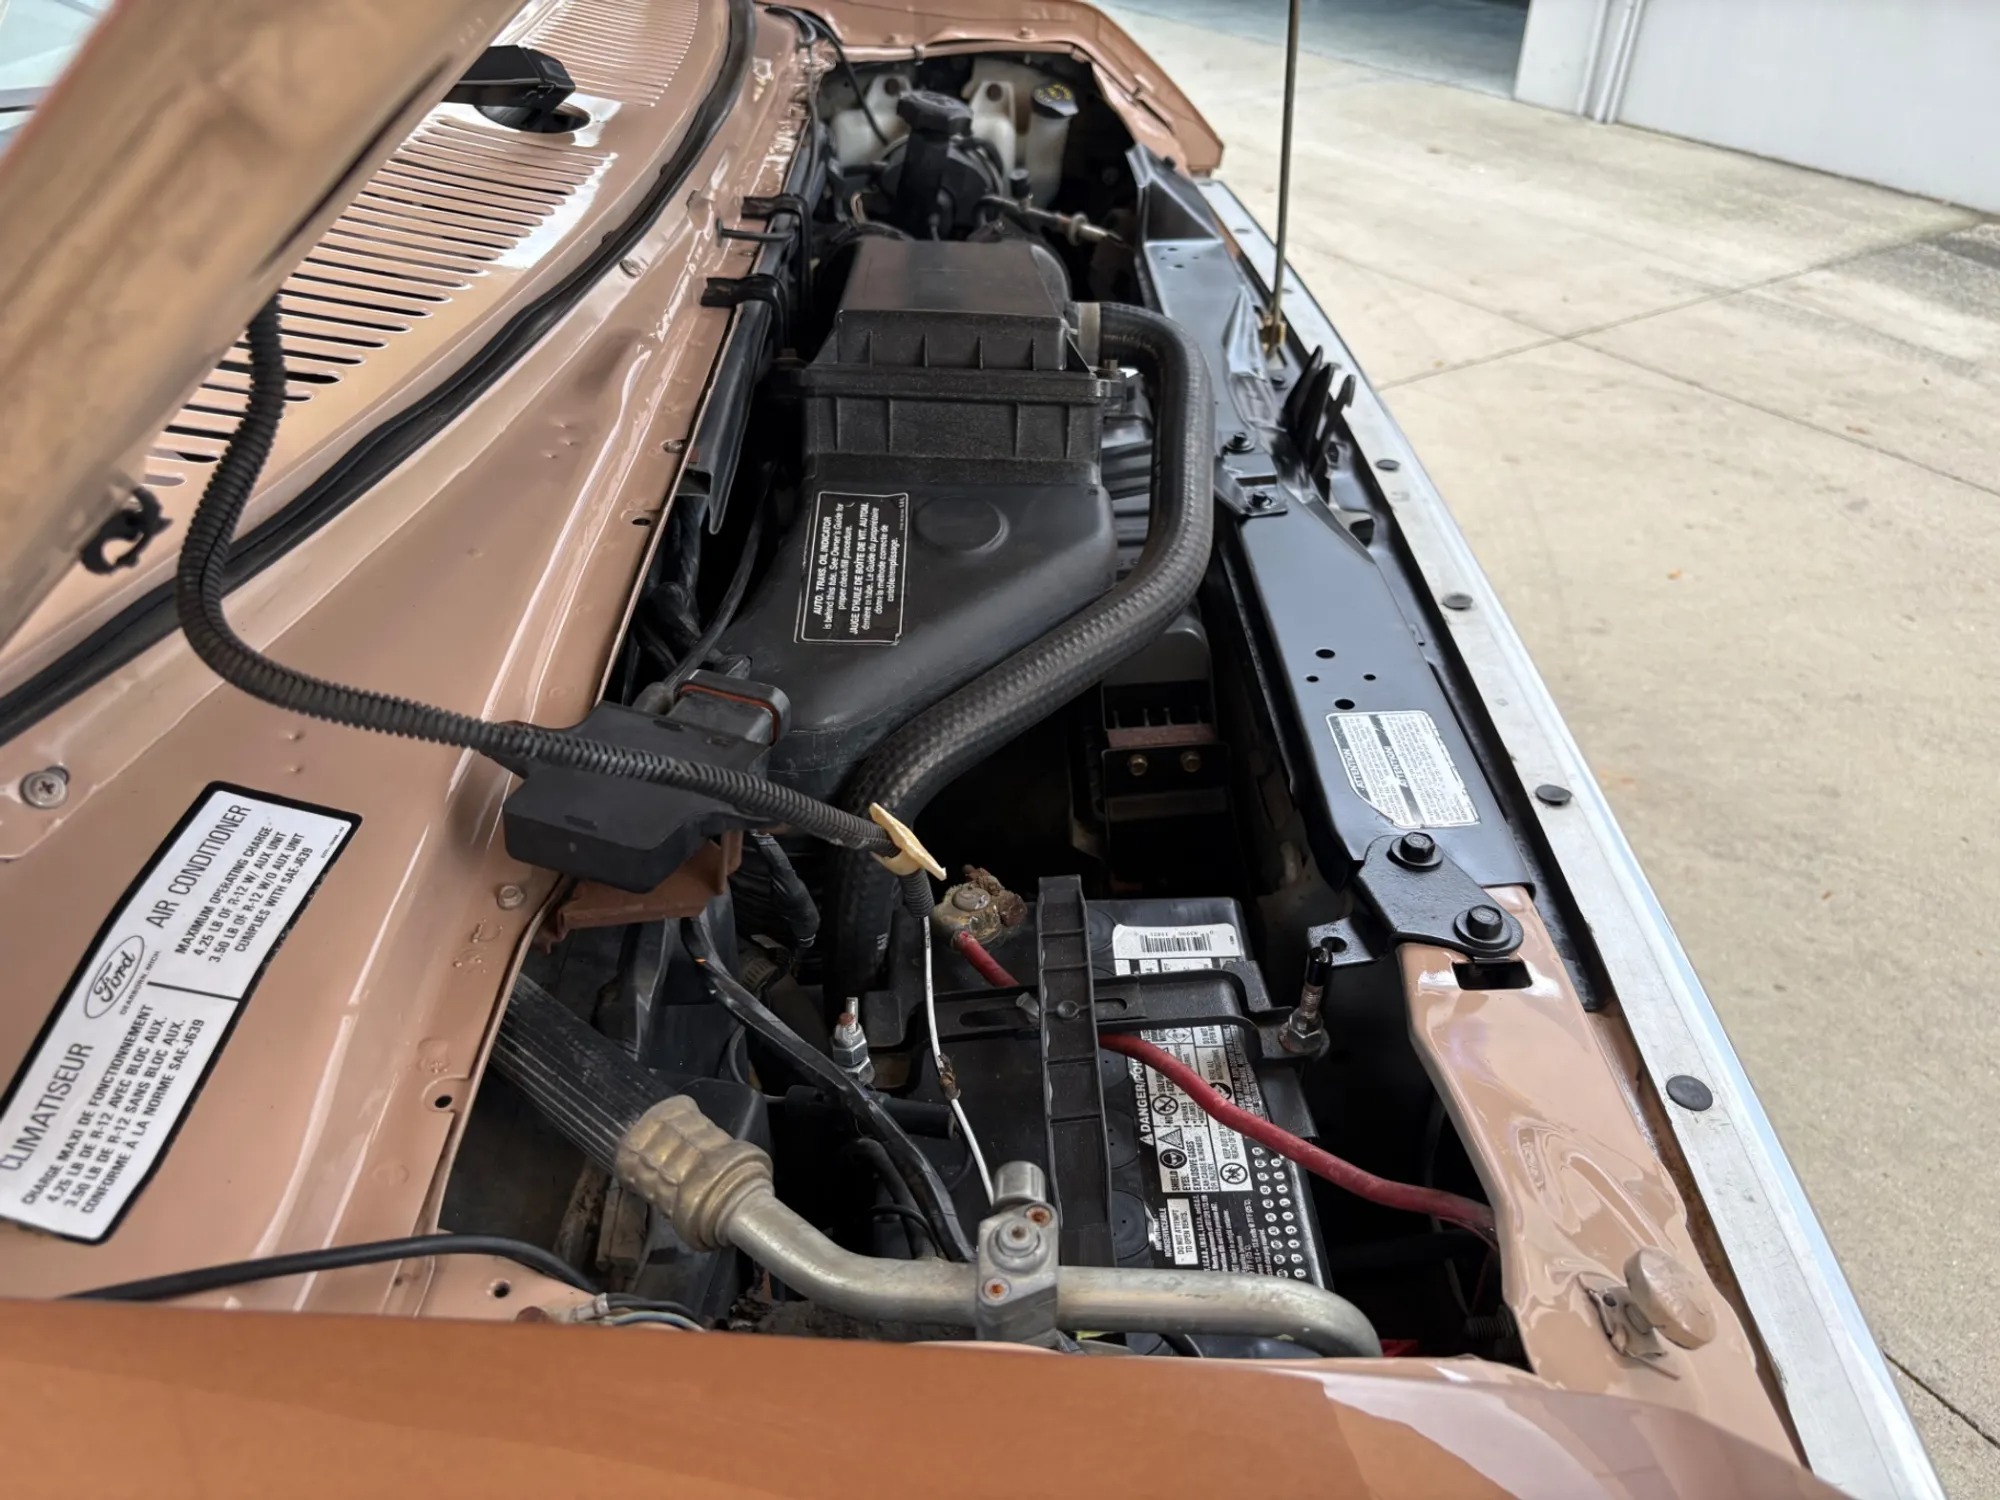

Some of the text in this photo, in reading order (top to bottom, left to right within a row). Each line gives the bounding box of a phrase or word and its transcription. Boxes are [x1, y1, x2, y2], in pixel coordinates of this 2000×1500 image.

[833, 511, 843, 529] Guide
[880, 524, 888, 532] de
[819, 516, 832, 552] INDICATOR
[856, 541, 865, 551] DE
[867, 542, 876, 551] du
[818, 552, 828, 565] OIL
[829, 557, 839, 570] See
[865, 552, 875, 572] Guide
[853, 574, 863, 585] DE
[812, 592, 824, 614] AUTO.
[826, 586, 836, 600] this
[837, 587, 848, 609] proper
[823, 600, 834, 622] behind
[849, 612, 860, 634] JAUGE
[1341, 748, 1366, 788] ATTENTION
[144, 803, 252, 930] AIR CONDITIONER
[173, 825, 273, 956] MAXIMUM OPERATING CHARGE
[191, 831, 287, 957] 4.25 LB OF R-12 W/ AUX UNIT
[206, 832, 306, 965] 3.50 LB OF R-12 W/O AUX UNIT
[232, 846, 314, 954] COMPLIES WITH SAE-J639
[88, 944, 137, 1005] Ford
[20, 1003, 154, 1203] CHARGE MAXI DE FONCTIONNEMENT
[1131, 1058, 1151, 1132] DANGER/POI
[0, 1040, 95, 1173] CLIMATISEUR
[45, 1012, 168, 1201] 4.25 LB DE R-12 AVEC BLOC AUX.
[62, 1014, 186, 1207] 3.50 LB DE R-12 SANS BLOC AUX.
[80, 1152, 131, 1213] CONFORME
[130, 1116, 150, 1138] LA
[141, 1070, 175, 1118] NORME
[166, 1016, 205, 1073] SAE-J639
[1185, 1140, 1201, 1190] EXPLOSIVE GASES
[1198, 1162, 1208, 1178] CAUSE
[1168, 1170, 1180, 1190] SHIELD
[1201, 1179, 1211, 1190] CAN
[1171, 1209, 1182, 1233] ATTEMPT
[1182, 1229, 1192, 1244] OPEN
